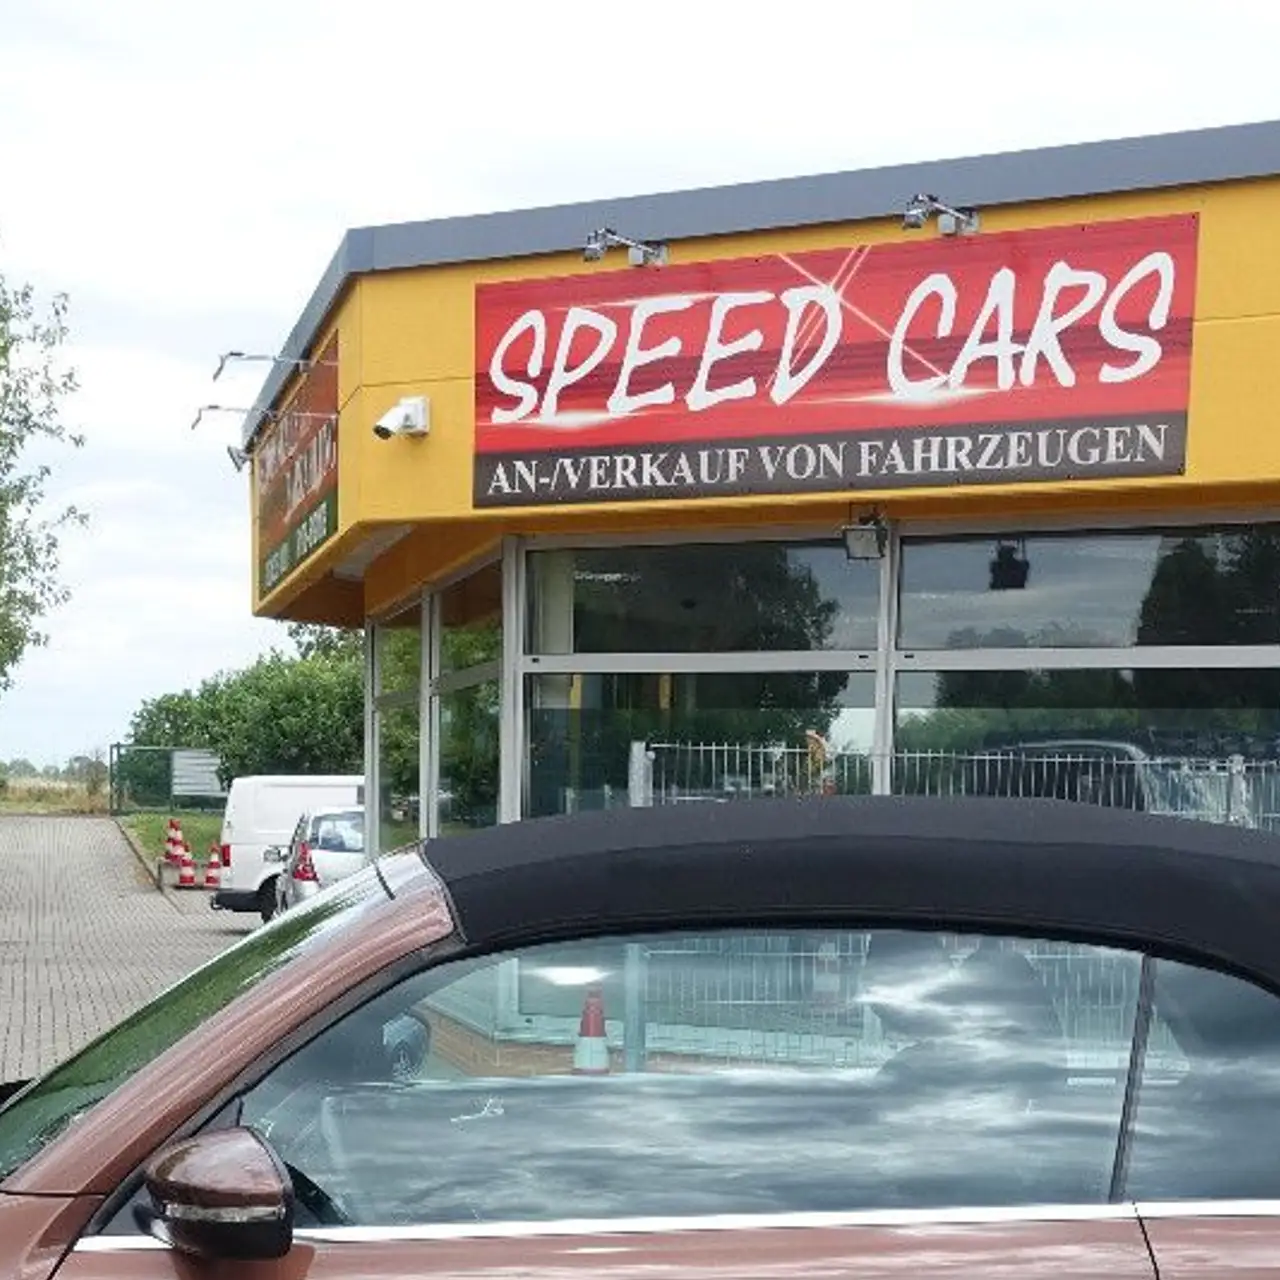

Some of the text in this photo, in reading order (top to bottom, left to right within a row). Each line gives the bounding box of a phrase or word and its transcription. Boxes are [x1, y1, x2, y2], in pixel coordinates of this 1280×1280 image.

[489, 251, 1175, 423] SPEED CARS
[487, 424, 1169, 495] AN-/VERKAUF VON FAHRZEUGEN
